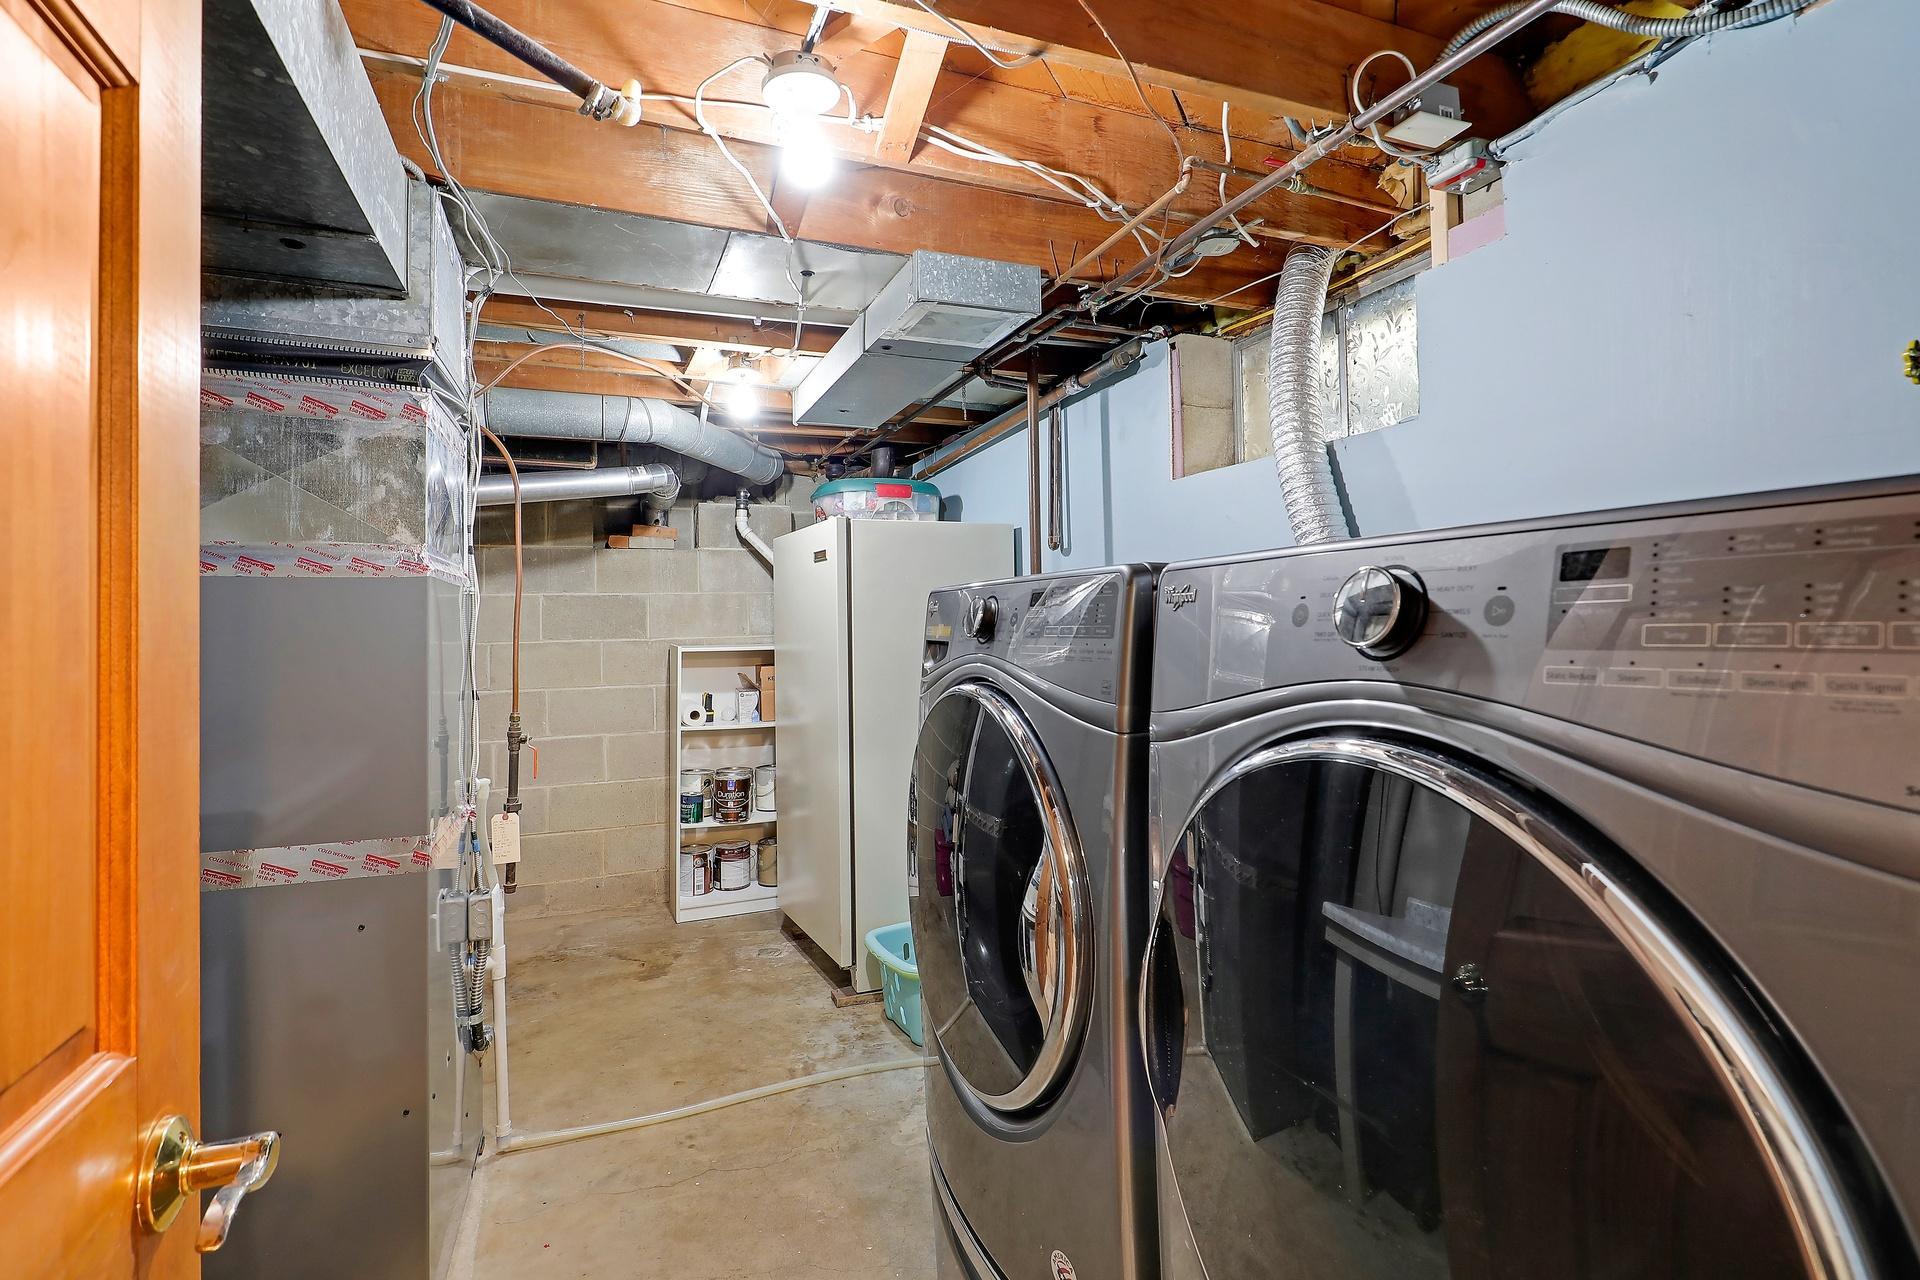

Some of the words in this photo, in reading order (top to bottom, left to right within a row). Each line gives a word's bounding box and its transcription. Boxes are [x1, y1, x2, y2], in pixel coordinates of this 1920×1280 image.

[717, 790, 745, 801] Duration
[260, 862, 299, 878] VentureTape
[311, 859, 349, 875] VentureTape
[365, 854, 401, 870] VentureTape
[202, 868, 242, 884] VentureTape
